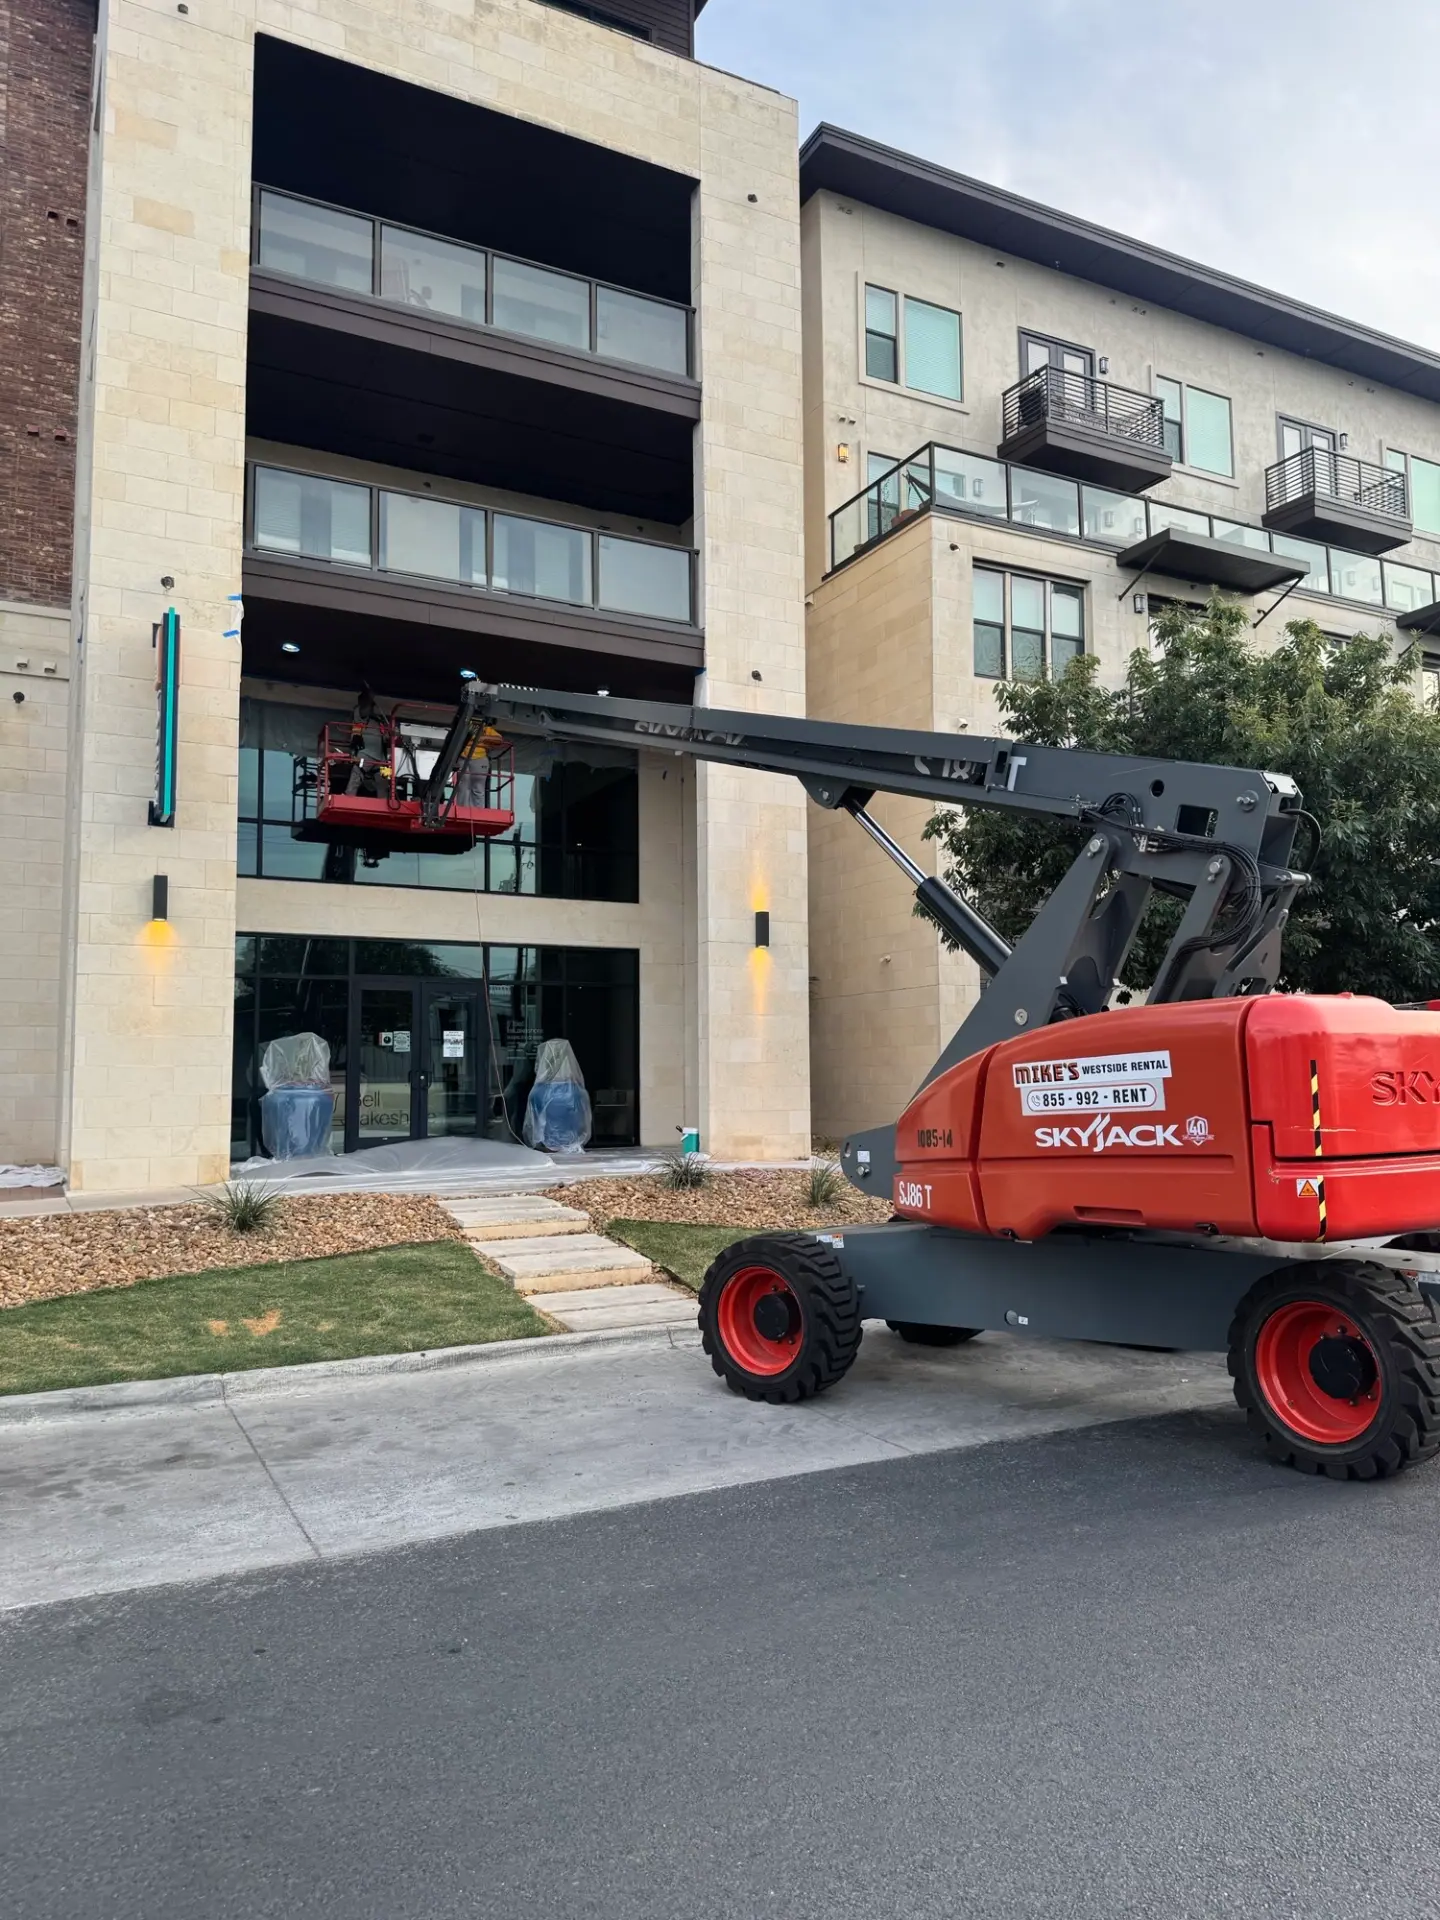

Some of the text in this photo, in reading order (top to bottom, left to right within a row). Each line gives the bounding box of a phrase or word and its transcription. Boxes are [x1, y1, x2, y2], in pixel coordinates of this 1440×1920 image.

[1015, 1059, 1168, 1084] MIKE'S WESTSIDE RENTAL
[358, 1090, 380, 1107] ell
[1034, 1112, 1184, 1152] SKYJACK
[1189, 1119, 1206, 1136] 40
